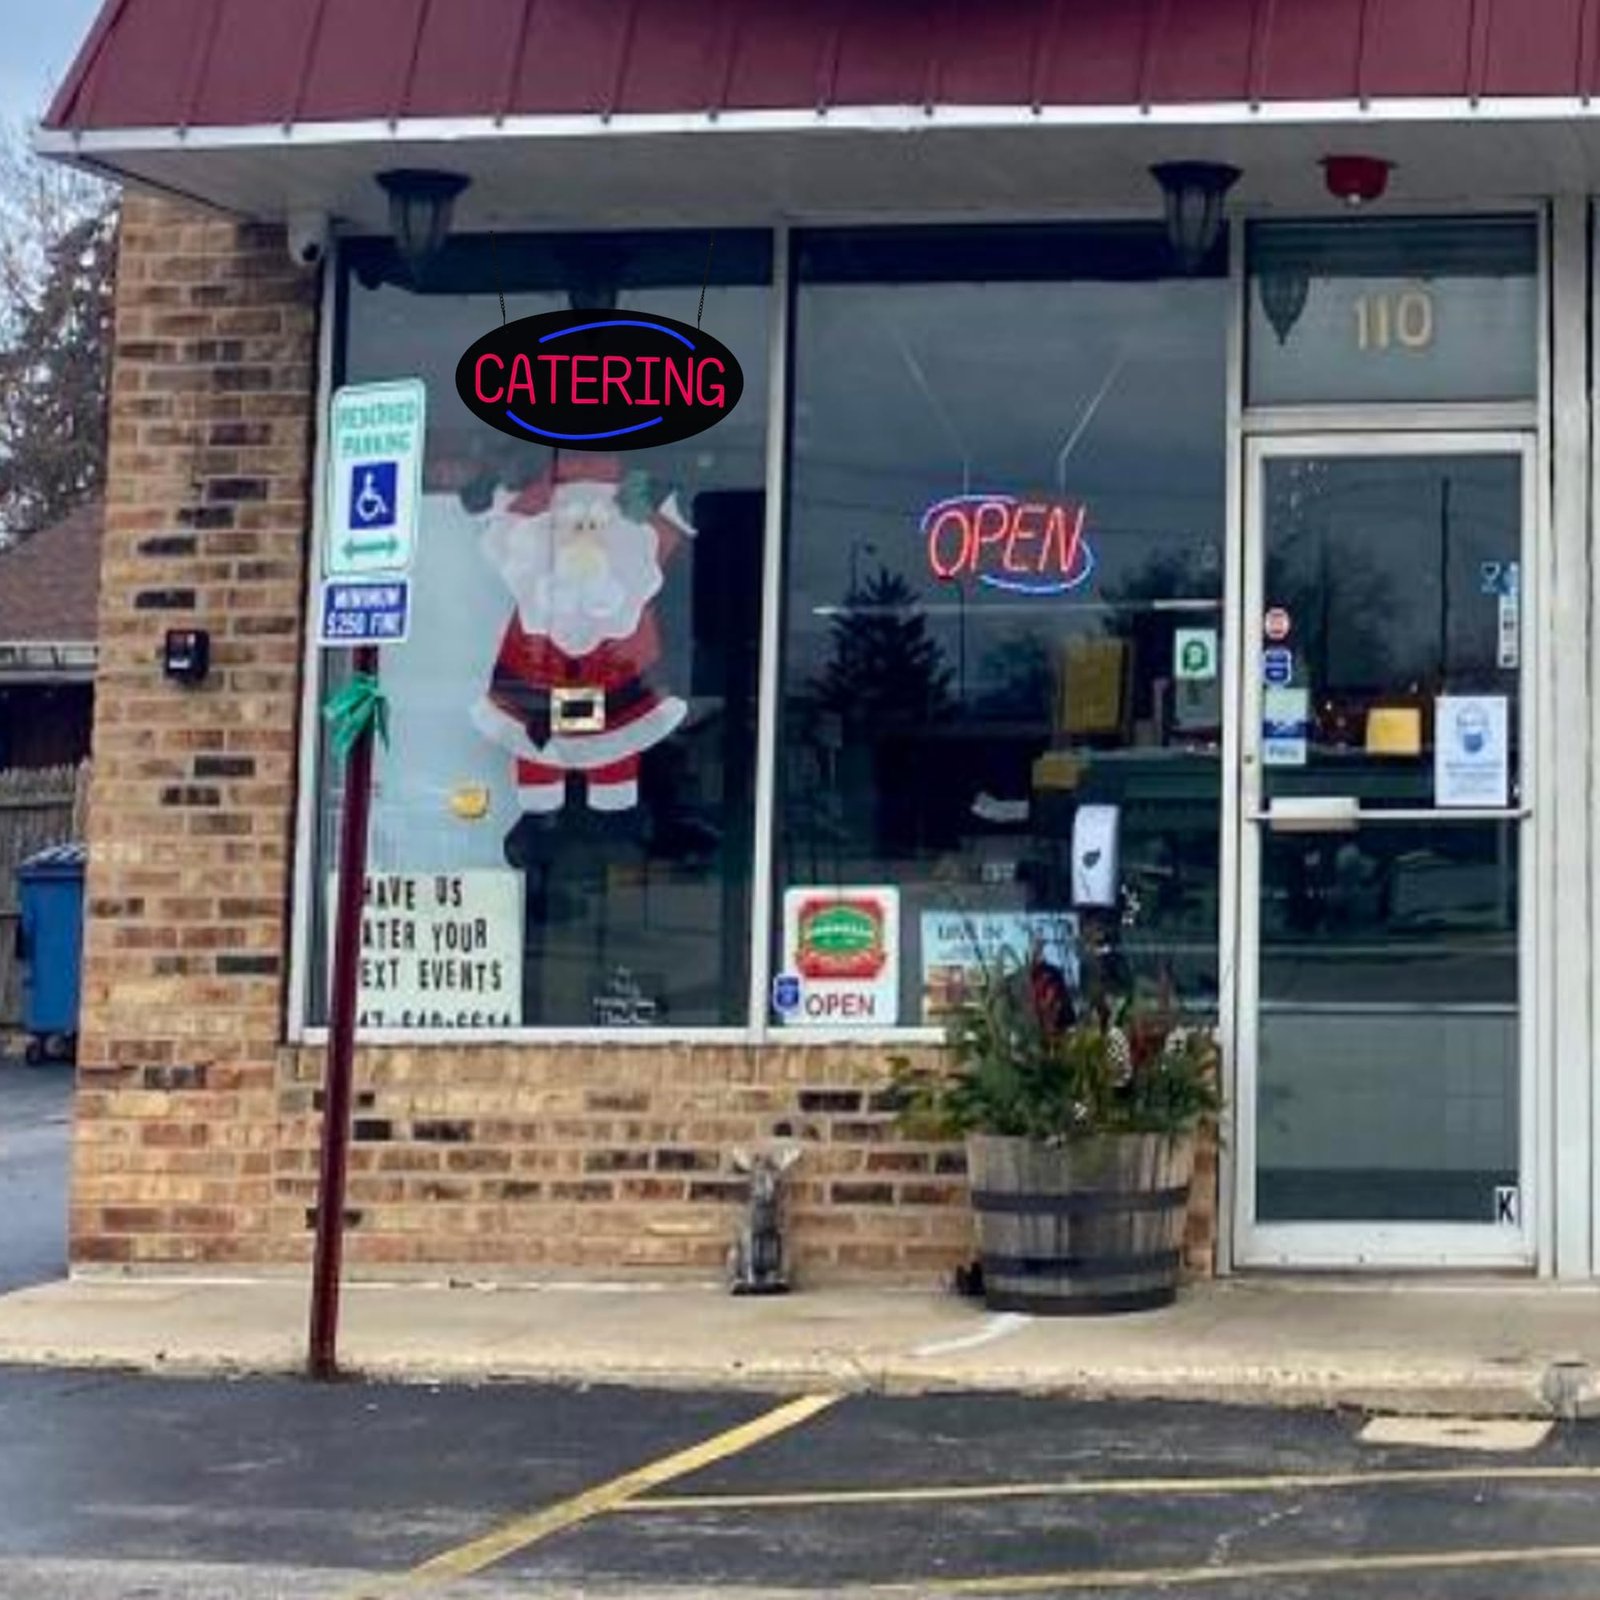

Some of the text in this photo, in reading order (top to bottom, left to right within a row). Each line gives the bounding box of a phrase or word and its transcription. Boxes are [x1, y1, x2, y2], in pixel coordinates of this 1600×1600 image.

[1354, 291, 1435, 350] 110
[474, 352, 726, 409] CATERING
[928, 502, 1087, 580] OPEN
[435, 876, 462, 908] US
[361, 917, 488, 953] ATER YOUR
[359, 958, 503, 994] EXT EVENTS
[804, 993, 875, 1017] OPEN
[1498, 1189, 1515, 1226] K
